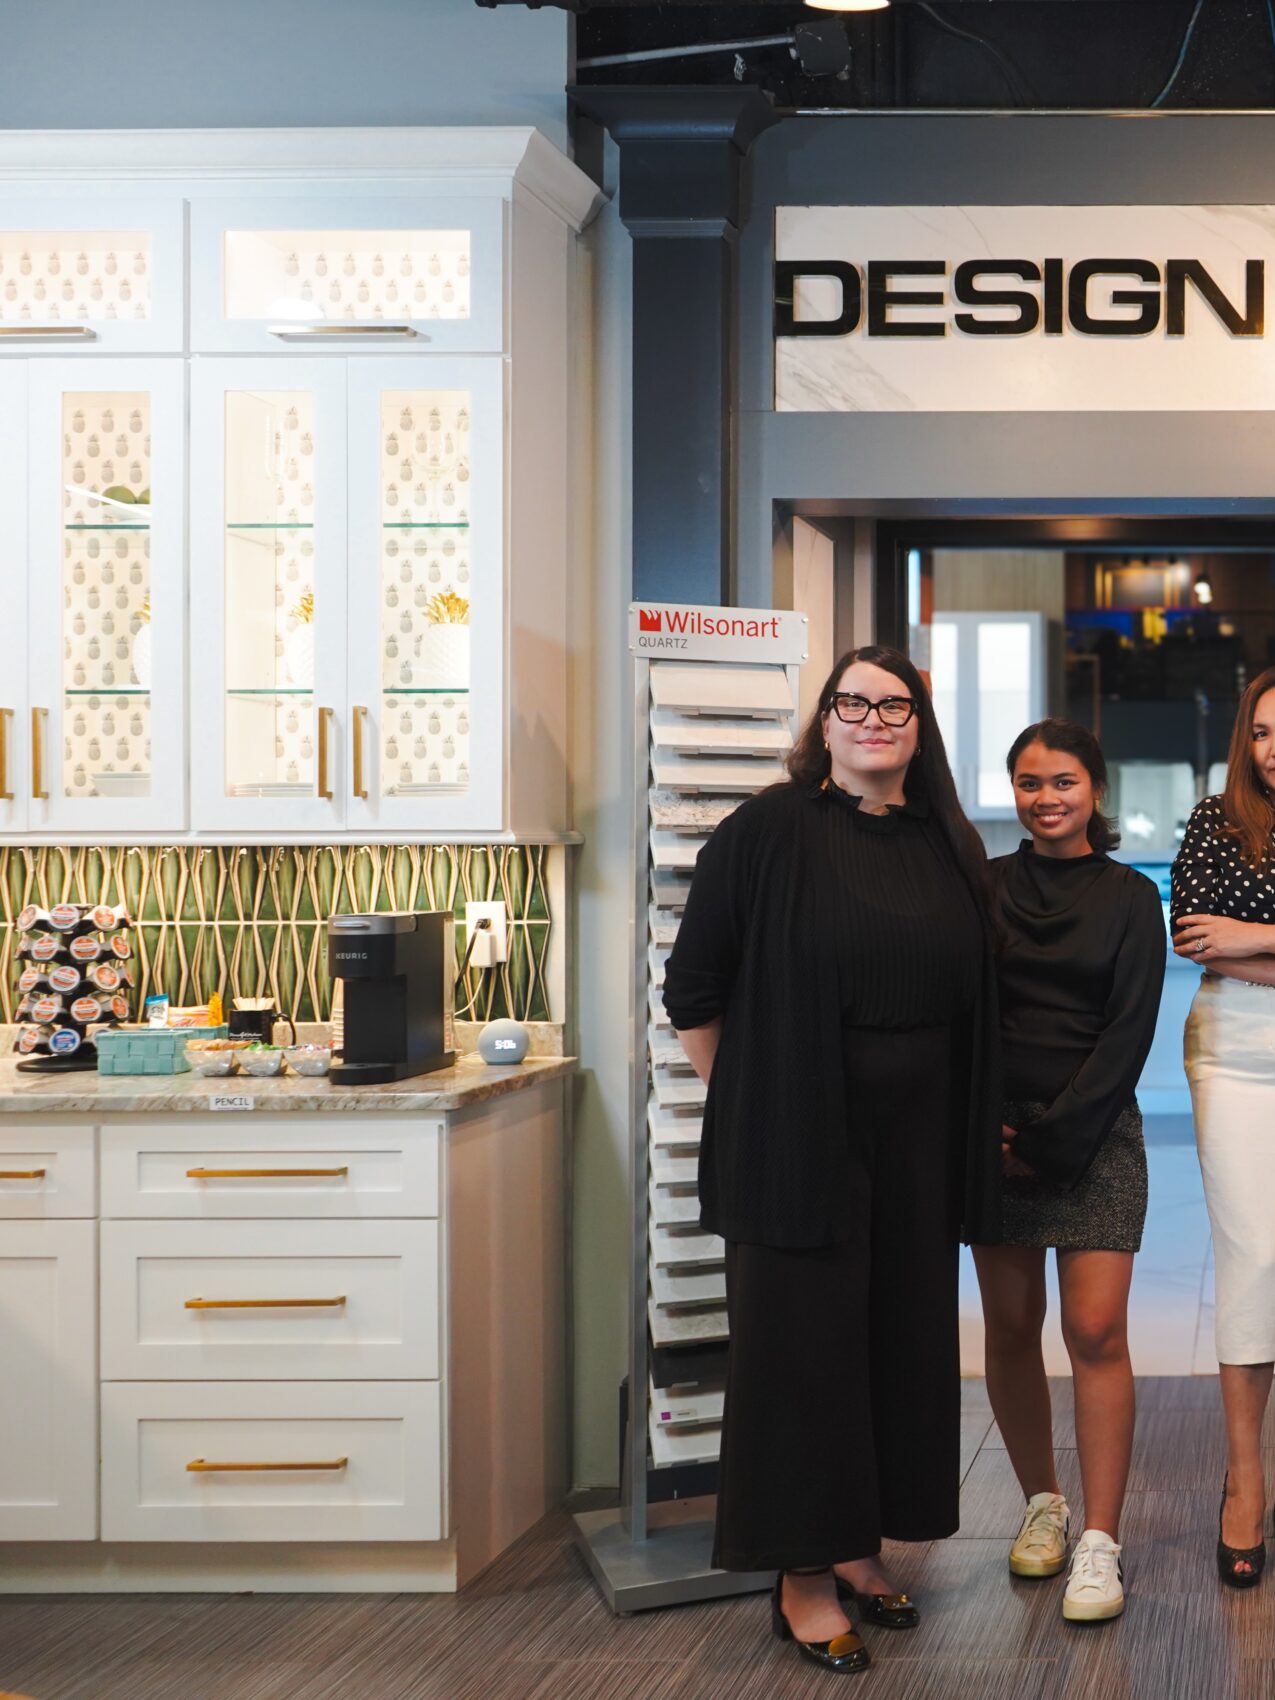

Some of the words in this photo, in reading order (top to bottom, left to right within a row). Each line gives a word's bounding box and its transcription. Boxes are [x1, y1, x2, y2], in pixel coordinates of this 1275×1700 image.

[775, 258, 1264, 338] DESIGN
[666, 611, 779, 638] Wilsonart
[638, 637, 688, 649] QUARTZ
[335, 952, 368, 960] KEURIG
[215, 1097, 250, 1106] PENCIL
